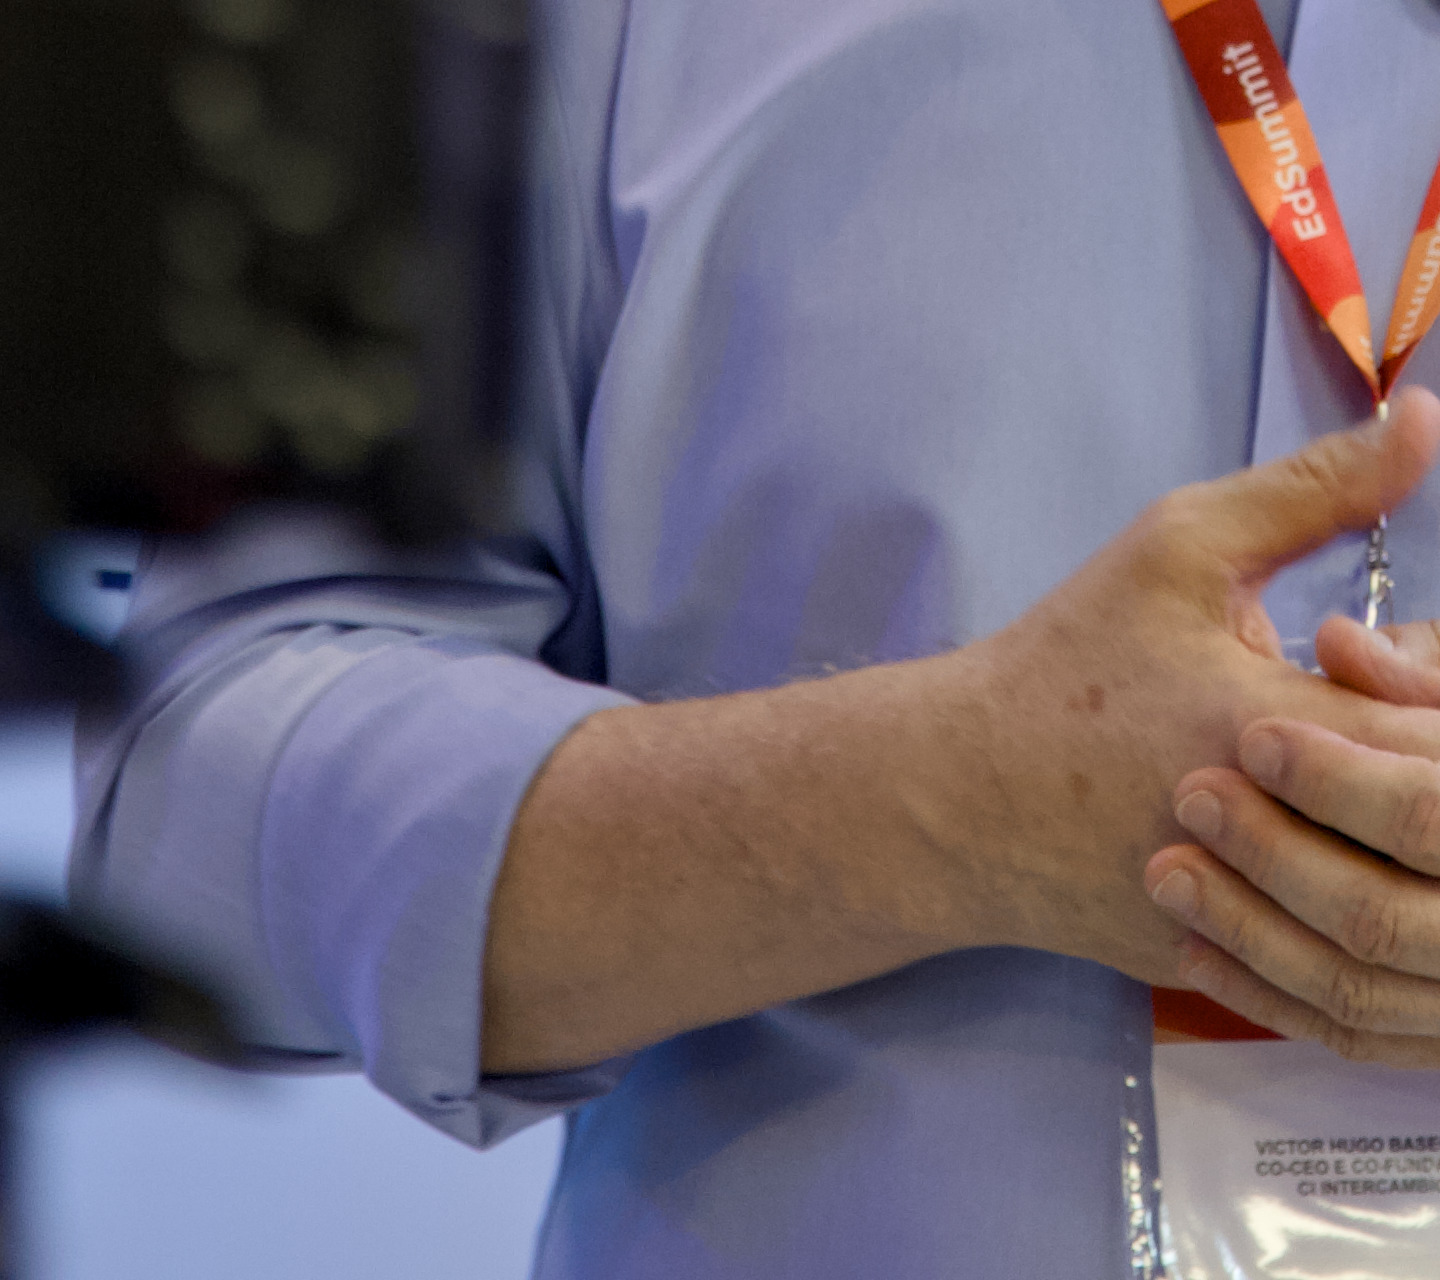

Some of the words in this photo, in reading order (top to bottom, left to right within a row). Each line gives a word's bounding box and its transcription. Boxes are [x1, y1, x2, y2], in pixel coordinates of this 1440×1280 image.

[1222, 40, 1327, 241] EdSummit
[1255, 1138, 1323, 1156] VICTOR
[1328, 1137, 1385, 1154] HUGO
[1256, 1158, 1329, 1177] CO-CEO
[1334, 1158, 1346, 1175] E
